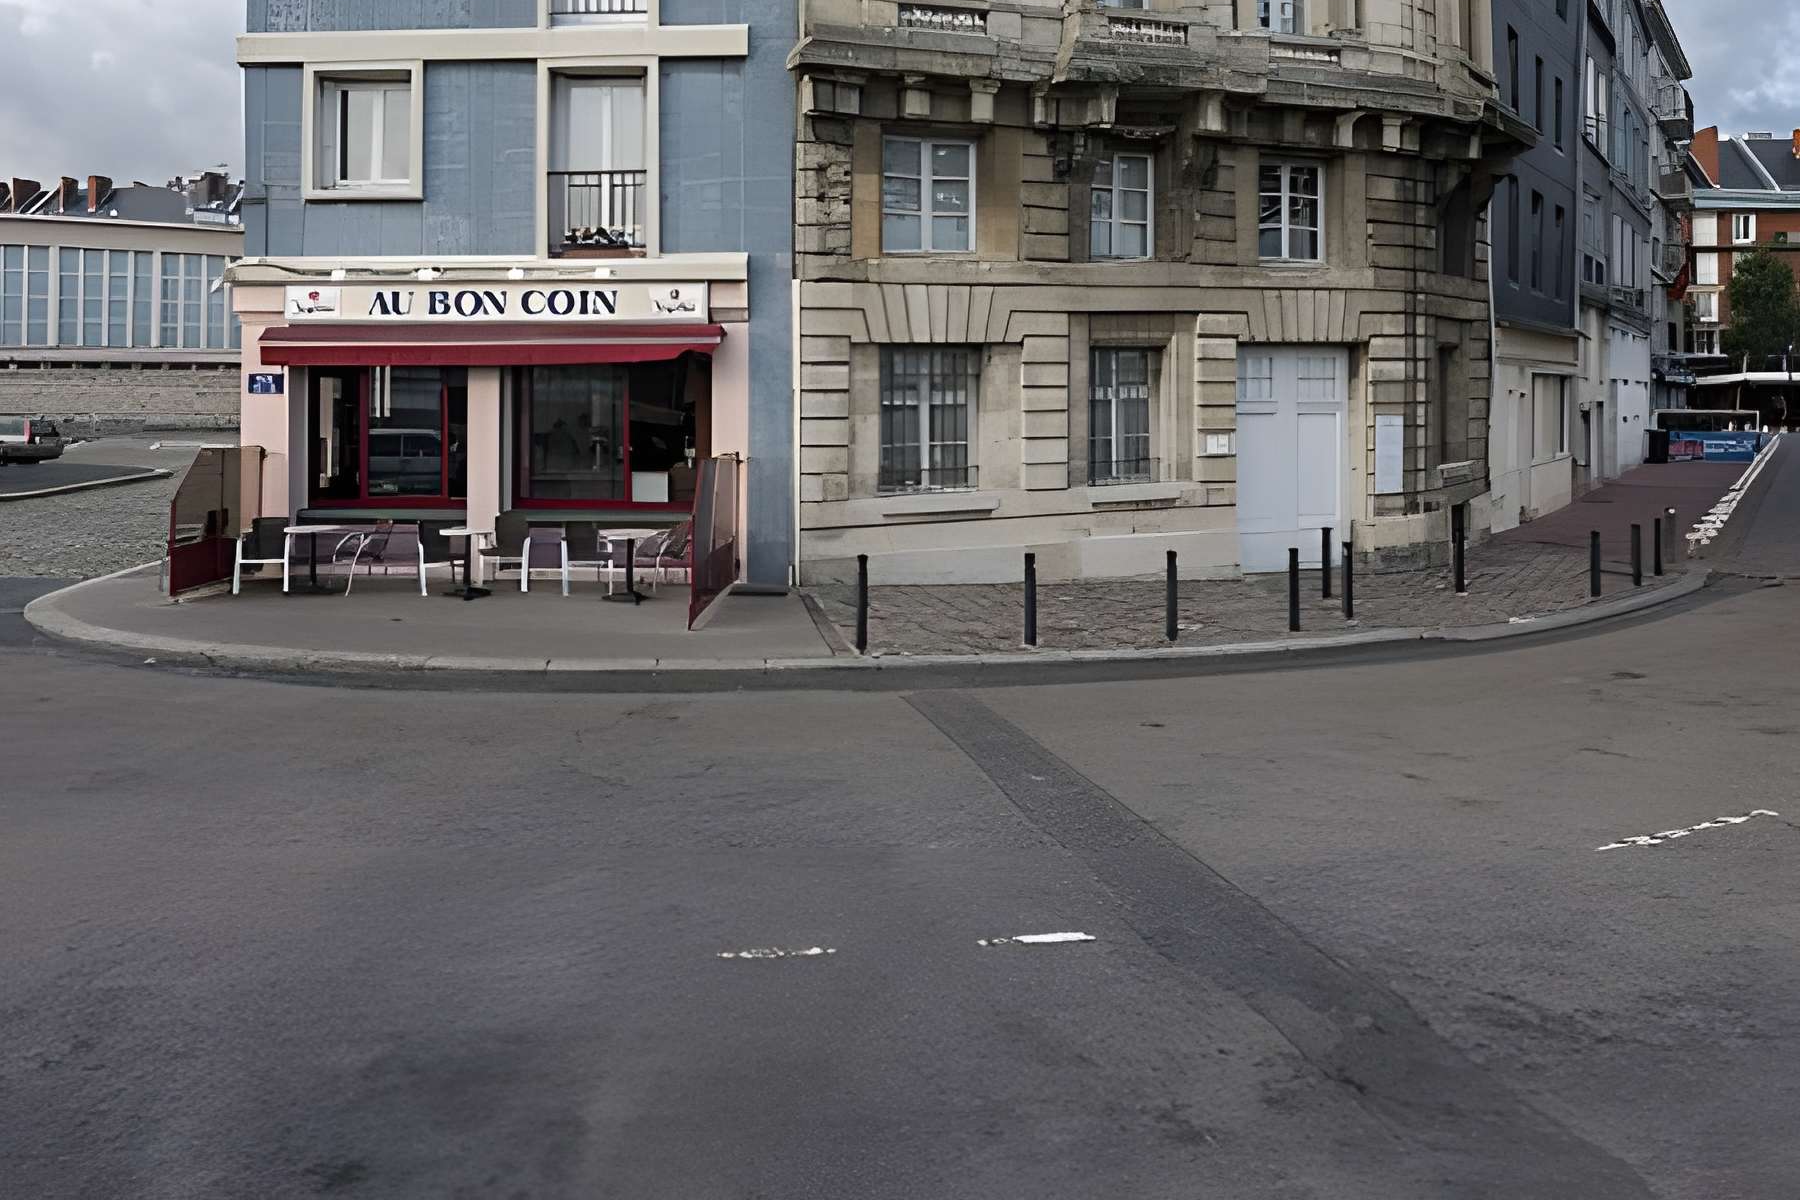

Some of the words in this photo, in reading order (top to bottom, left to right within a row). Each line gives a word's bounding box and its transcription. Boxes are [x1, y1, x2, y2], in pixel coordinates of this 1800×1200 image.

[368, 290, 414, 316] AU
[428, 289, 507, 317] BON
[521, 288, 618, 316] COIN
